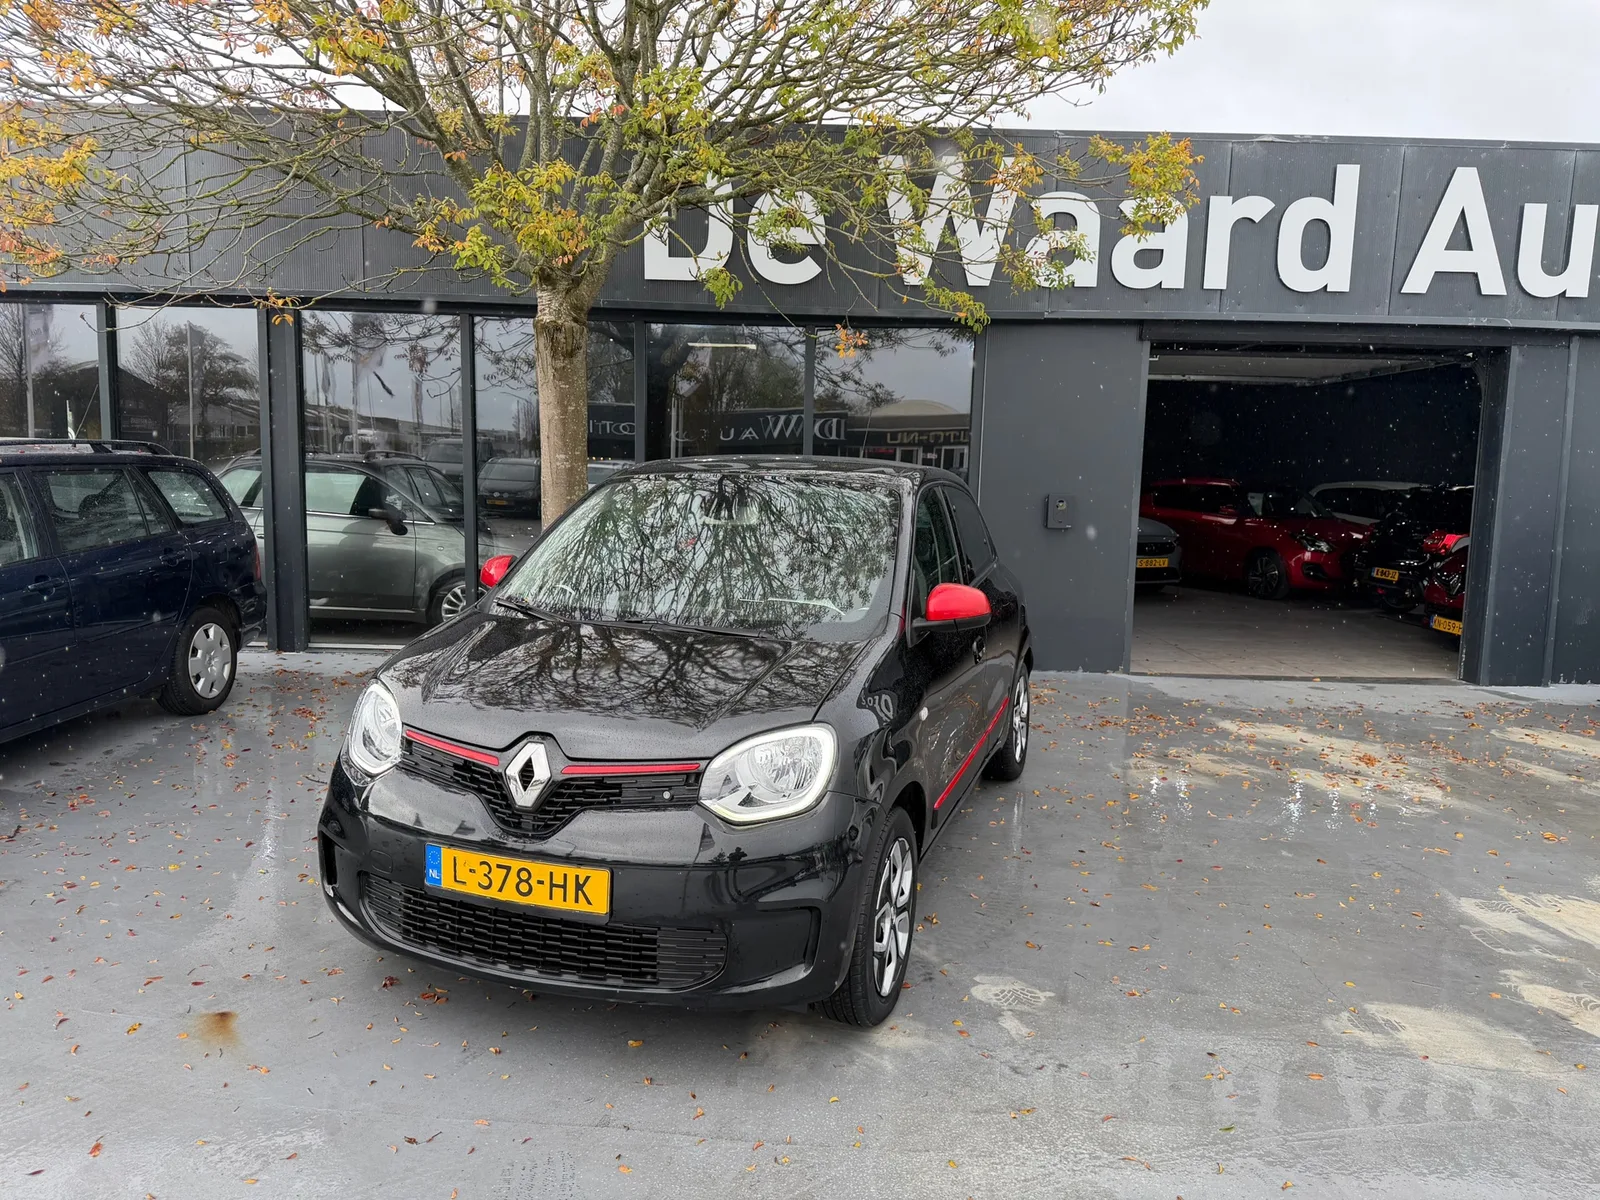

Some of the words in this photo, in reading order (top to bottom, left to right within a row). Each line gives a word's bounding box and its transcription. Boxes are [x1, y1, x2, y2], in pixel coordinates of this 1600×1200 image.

[644, 150, 826, 285] De
[878, 155, 1361, 293] Waard
[1400, 166, 1599, 298] Au
[428, 868, 440, 880] NL
[453, 856, 593, 906] L-378-HK
